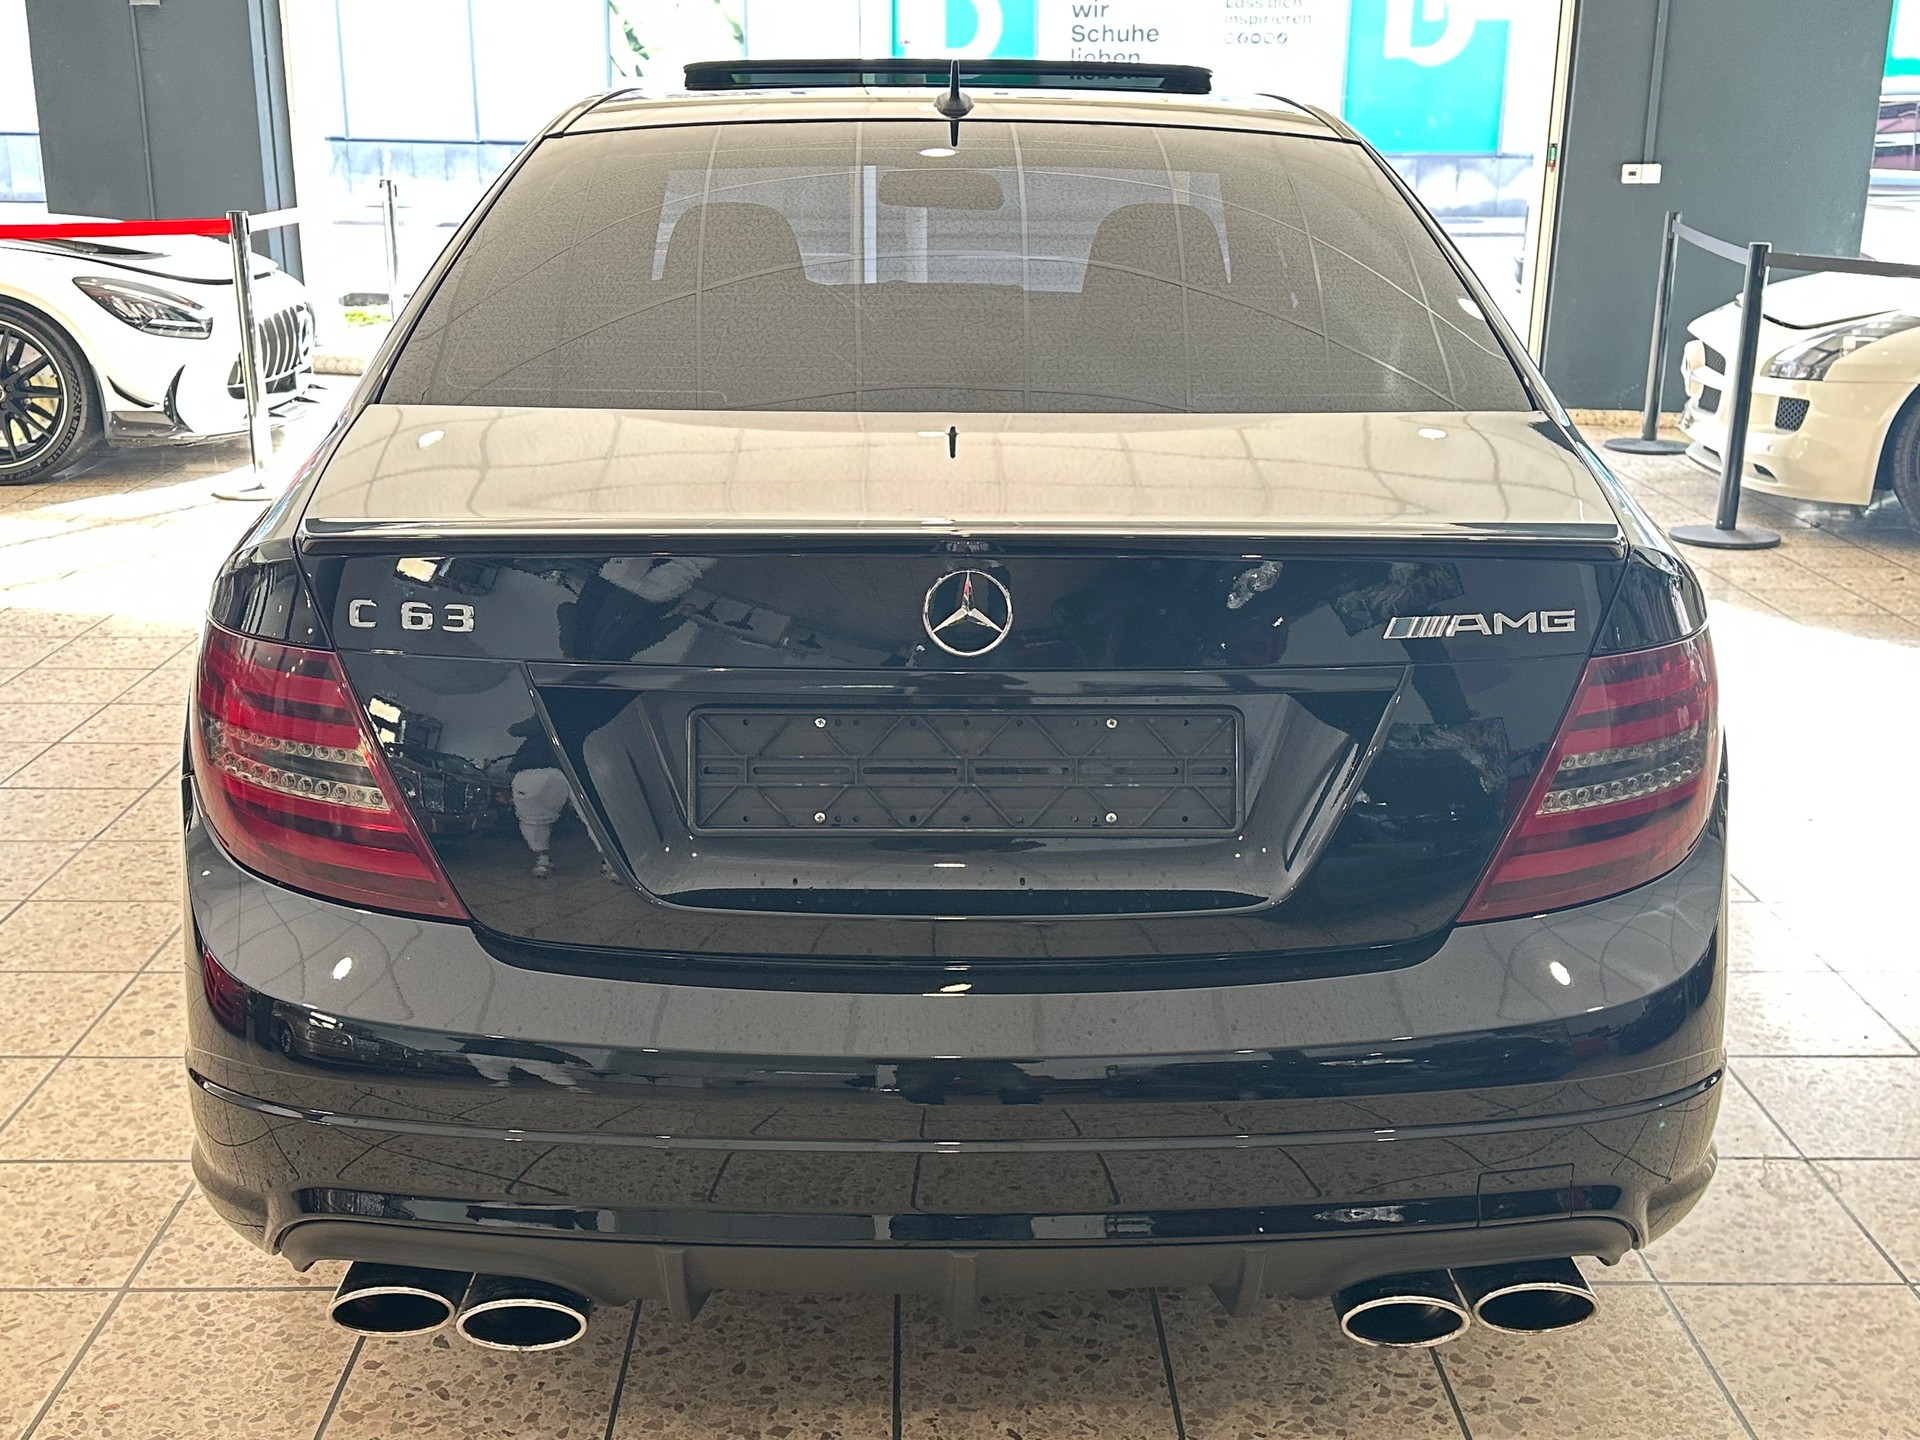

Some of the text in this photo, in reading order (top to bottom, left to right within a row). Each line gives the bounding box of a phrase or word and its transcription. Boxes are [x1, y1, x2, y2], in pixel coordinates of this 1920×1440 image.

[1071, 0, 1109, 18] wir
[1071, 24, 1160, 42] Schuhe
[349, 599, 475, 632] C 63
[1445, 609, 1576, 638] AMG
